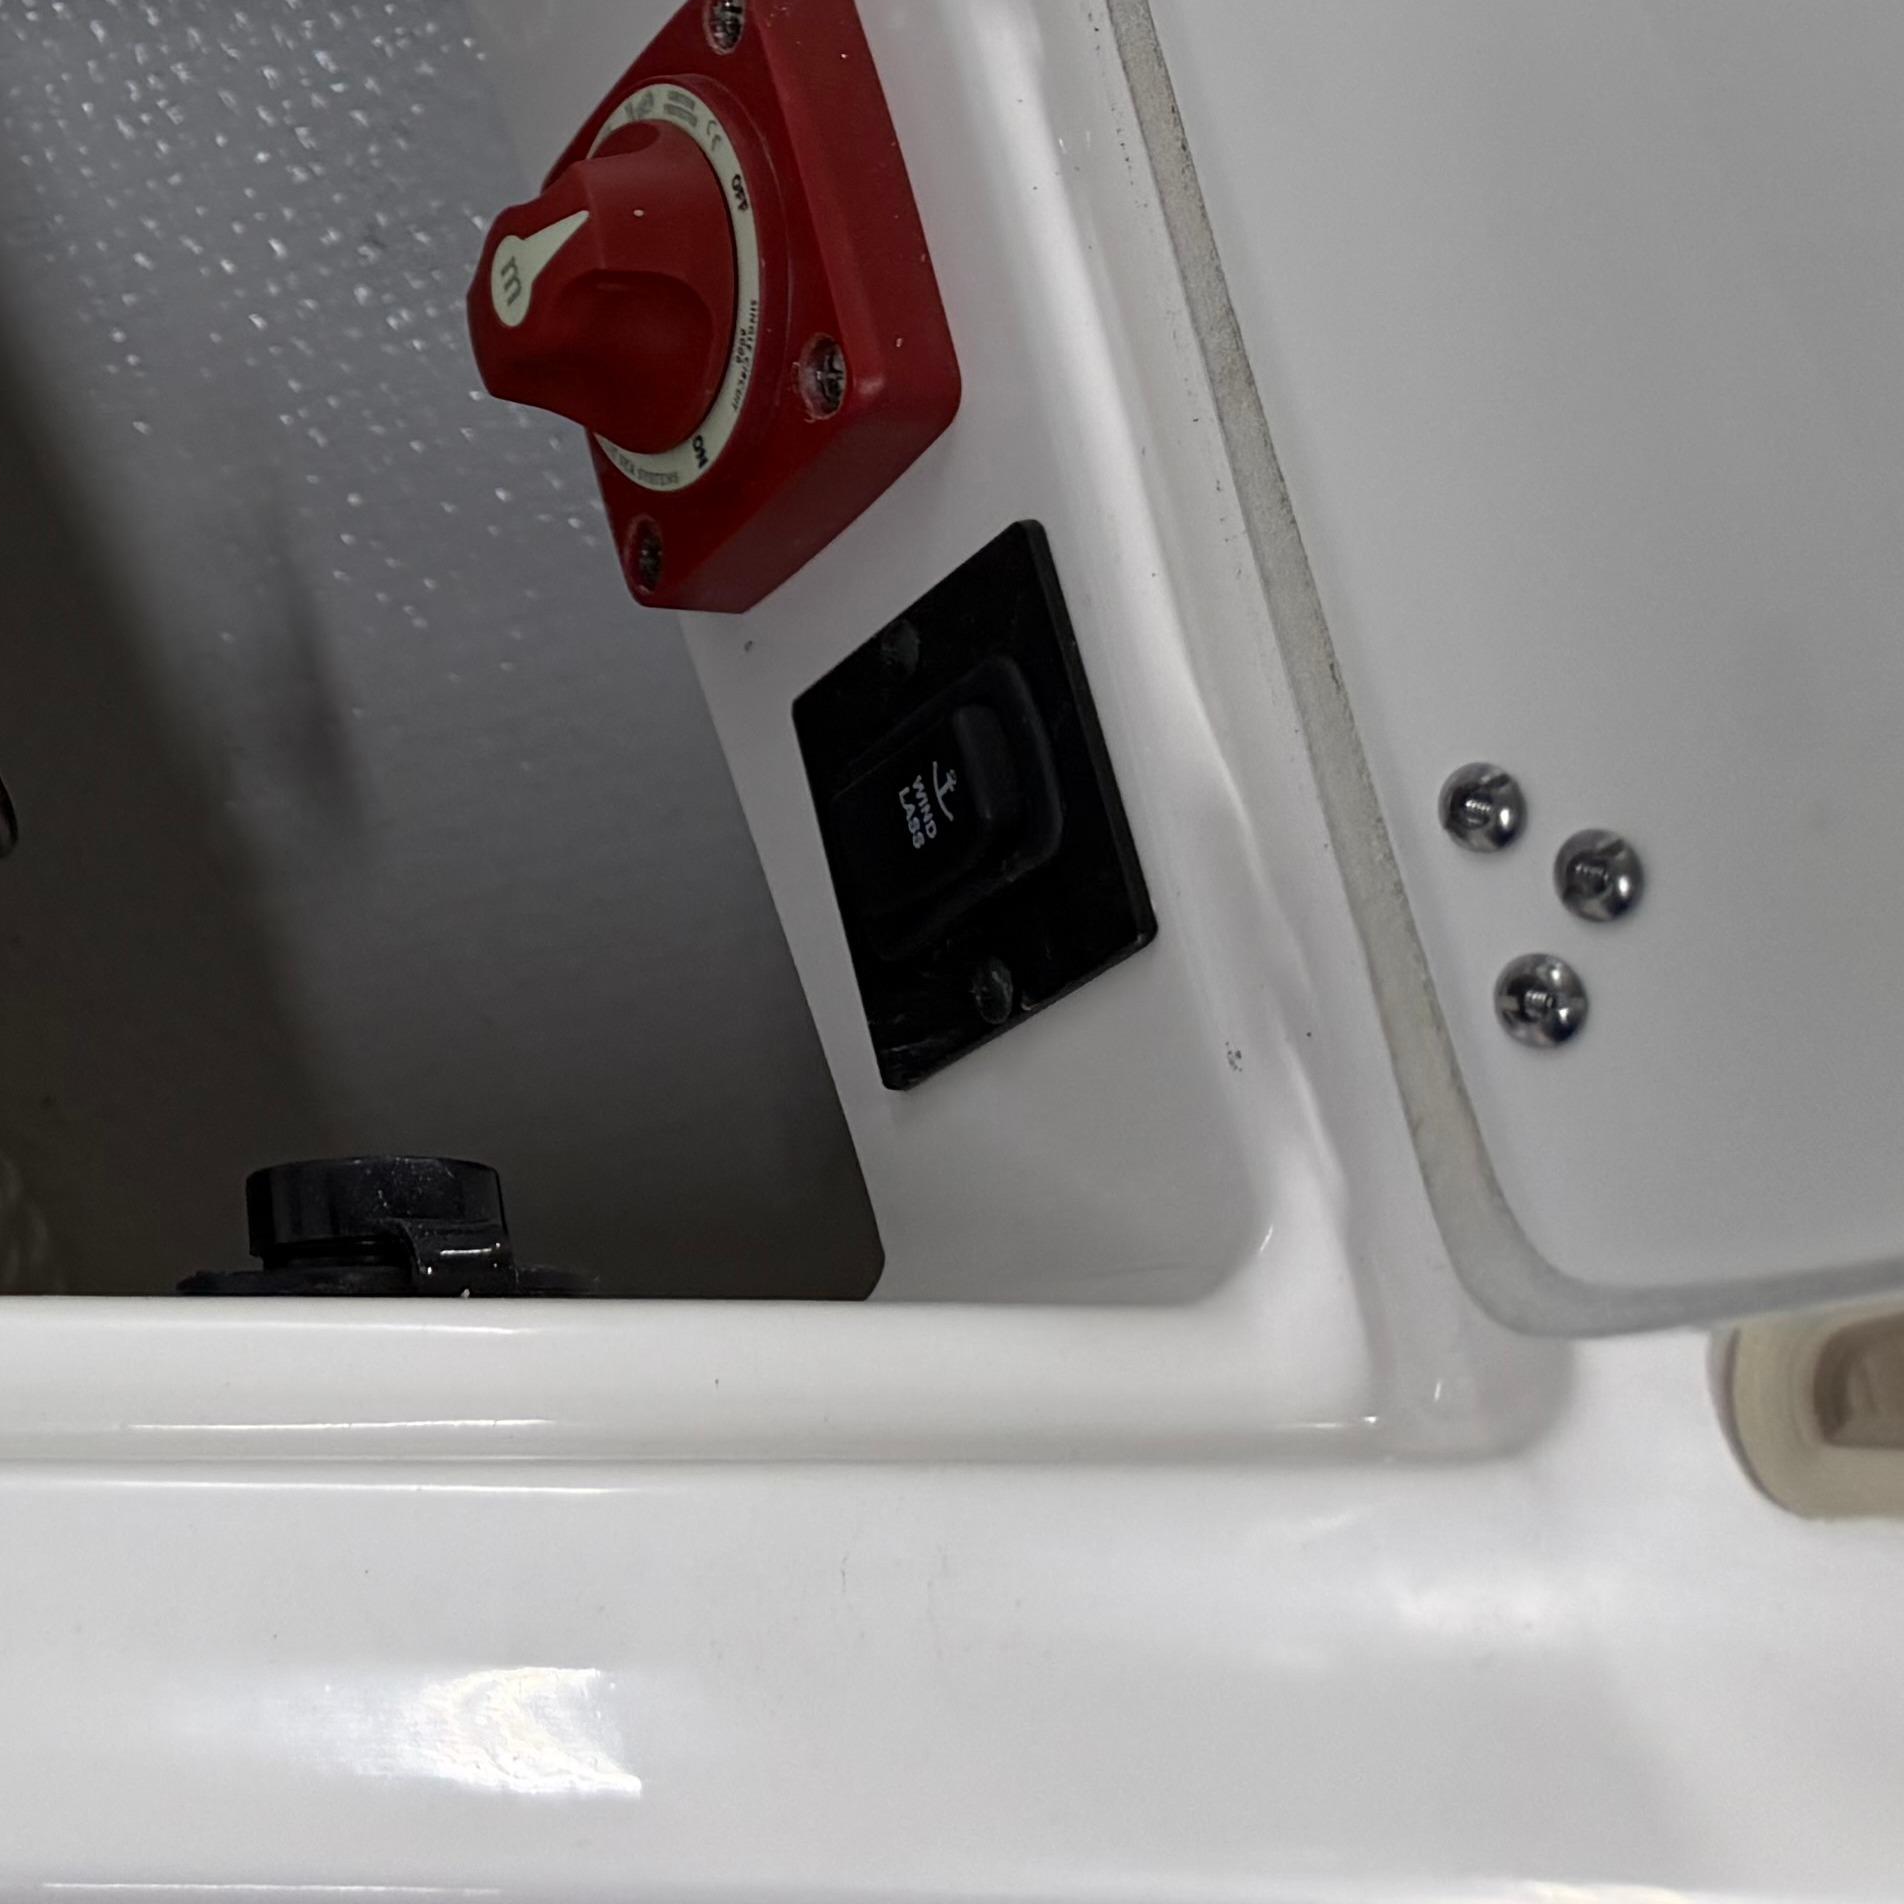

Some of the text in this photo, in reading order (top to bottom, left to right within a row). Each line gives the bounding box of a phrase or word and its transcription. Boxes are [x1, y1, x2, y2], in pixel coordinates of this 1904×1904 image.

[731, 173, 749, 211] OFF
[744, 298, 758, 353] SINGLE
[691, 434, 709, 470] ON
[898, 786, 925, 849] LASS
[912, 774, 938, 839] WIND
